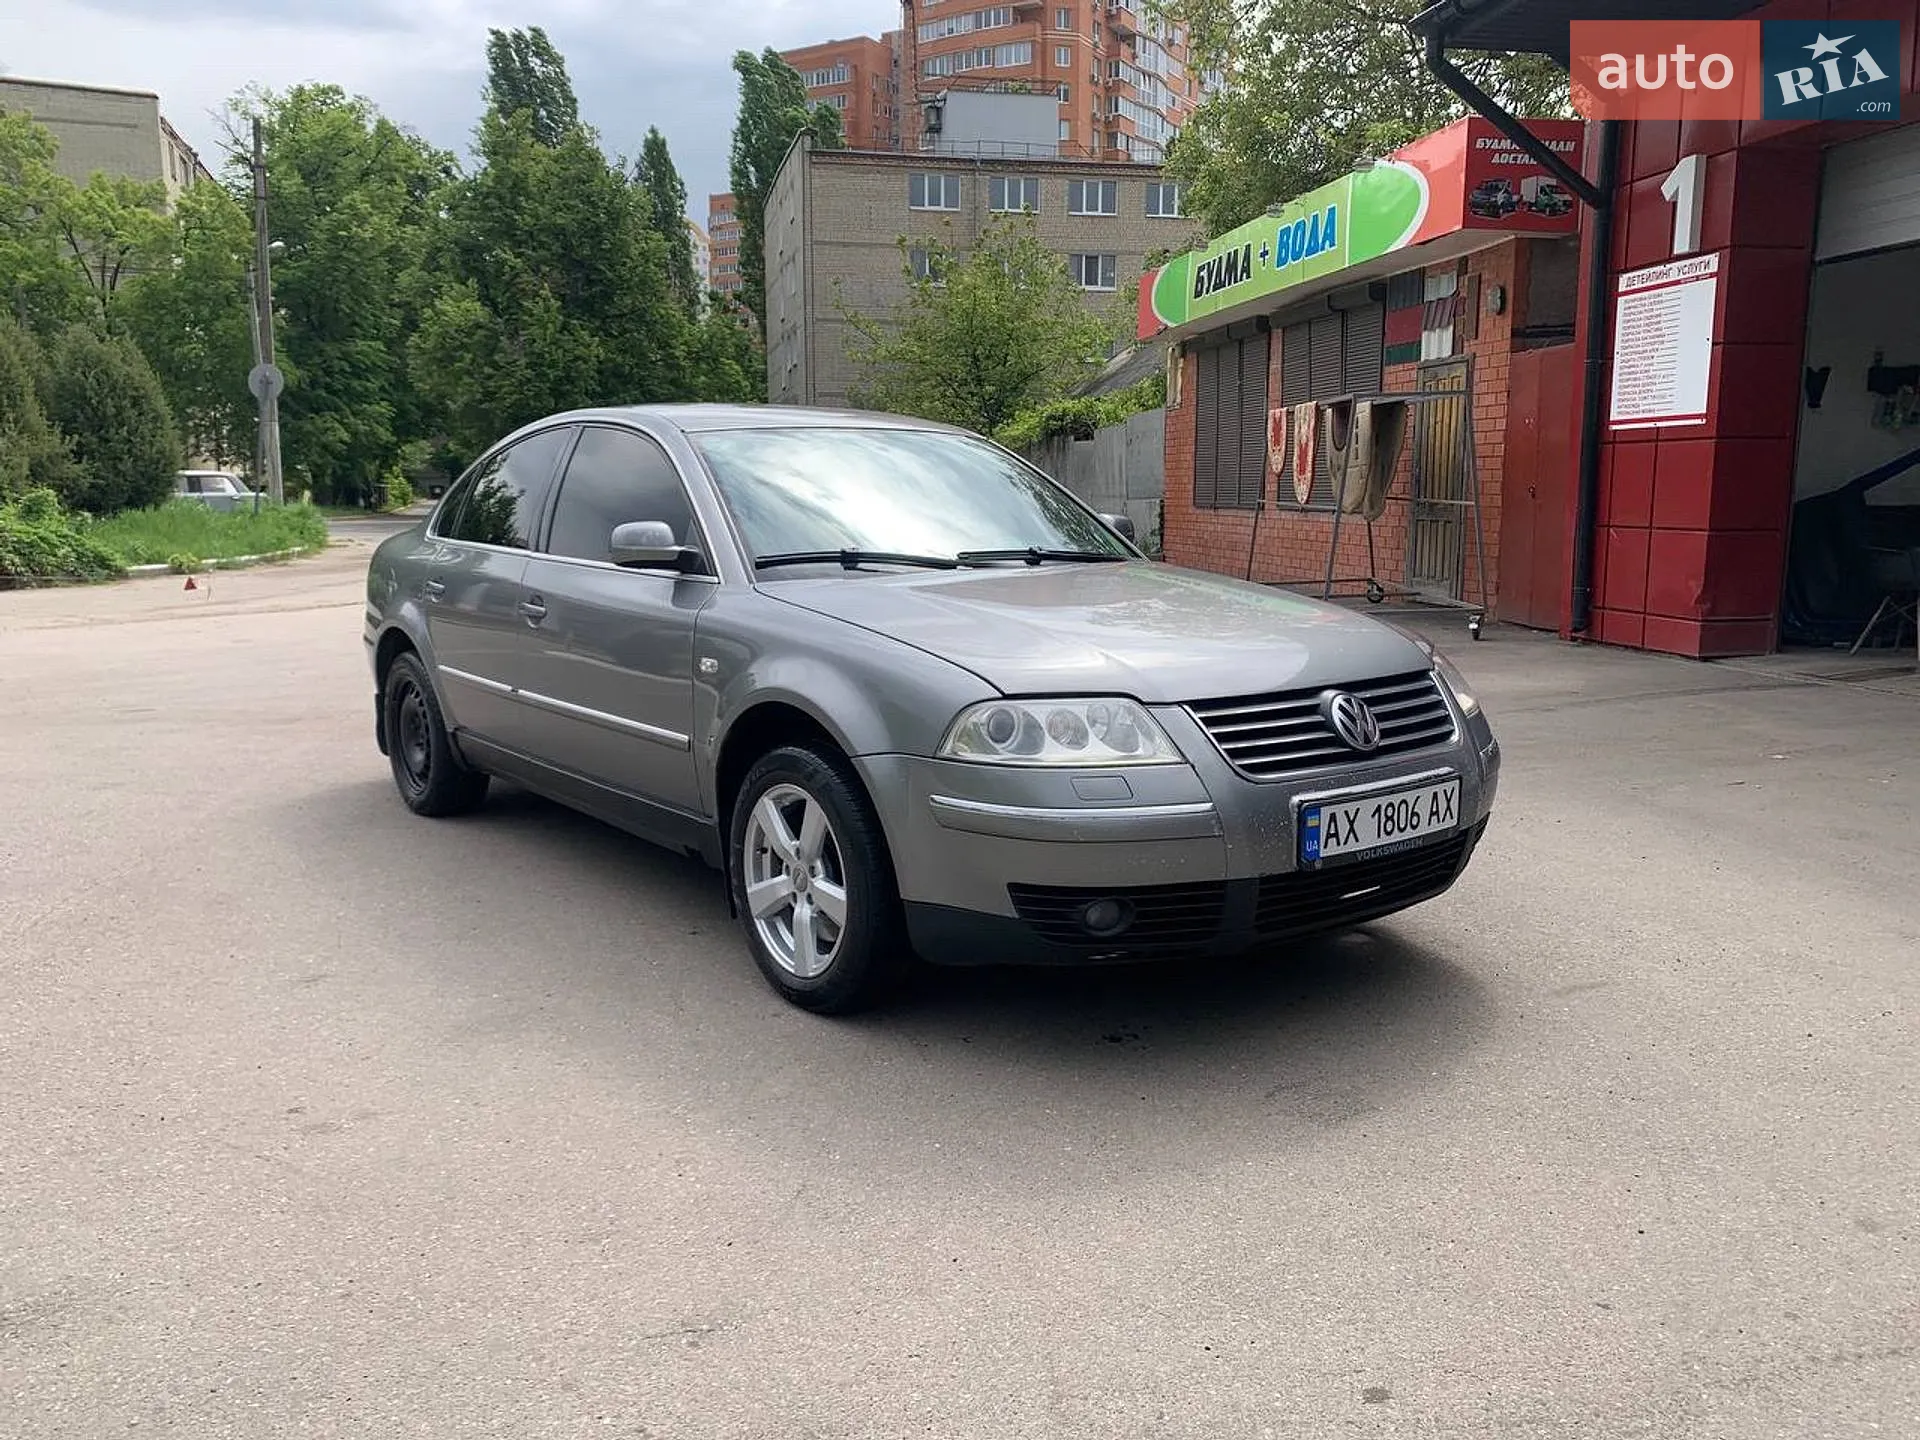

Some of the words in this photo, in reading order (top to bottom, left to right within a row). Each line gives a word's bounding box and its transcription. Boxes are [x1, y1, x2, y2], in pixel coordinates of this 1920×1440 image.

[1661, 154, 1706, 255] 1
[1193, 241, 1253, 300] БУДМА
[1275, 204, 1338, 270] ВОДА
[1676, 258, 1712, 277] УСЛУГИ
[1323, 807, 1361, 849] AX
[1370, 795, 1421, 839] 1806
[1427, 786, 1456, 826] AX
[1306, 840, 1320, 852] UA
[1355, 837, 1425, 861] VOLKSWAGEN
